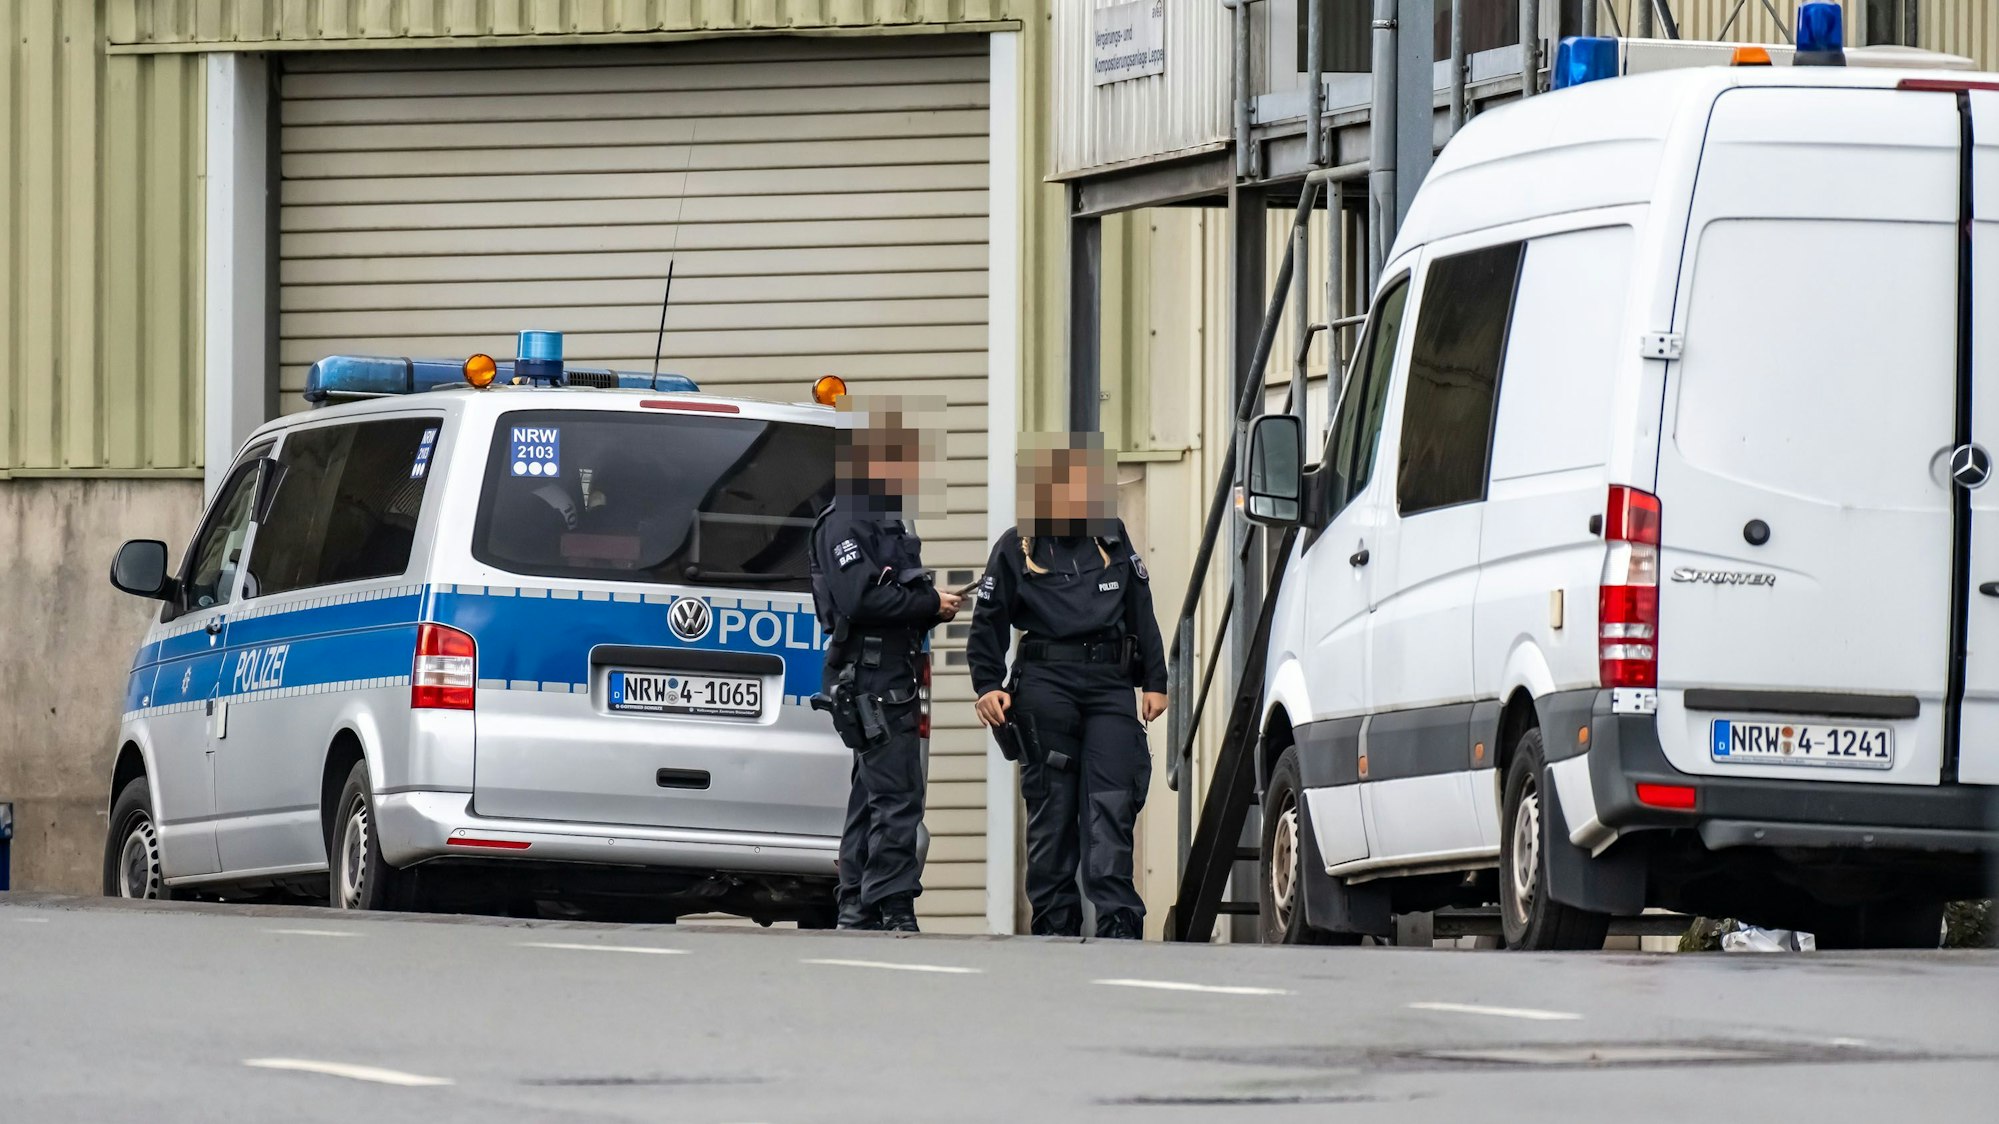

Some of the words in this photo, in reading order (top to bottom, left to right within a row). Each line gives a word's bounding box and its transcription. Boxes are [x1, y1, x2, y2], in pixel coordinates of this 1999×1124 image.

[1123, 24, 1132, 41] und
[1095, 49, 1148, 75] Kompostierungsanlage
[1148, 47, 1163, 66] Leppe
[421, 430, 438, 444] NRW
[513, 428, 557, 444] NRW
[517, 446, 554, 459] 2103
[839, 550, 857, 567] BAT
[1098, 581, 1120, 592] POLIZEI
[233, 644, 290, 693] POLIZEI
[614, 691, 621, 699] D
[625, 677, 666, 702] NRW
[680, 680, 758, 706] 4-1065
[1718, 741, 1726, 750] D
[1732, 725, 1779, 753] NRW
[1798, 727, 1888, 758] 4-1241
